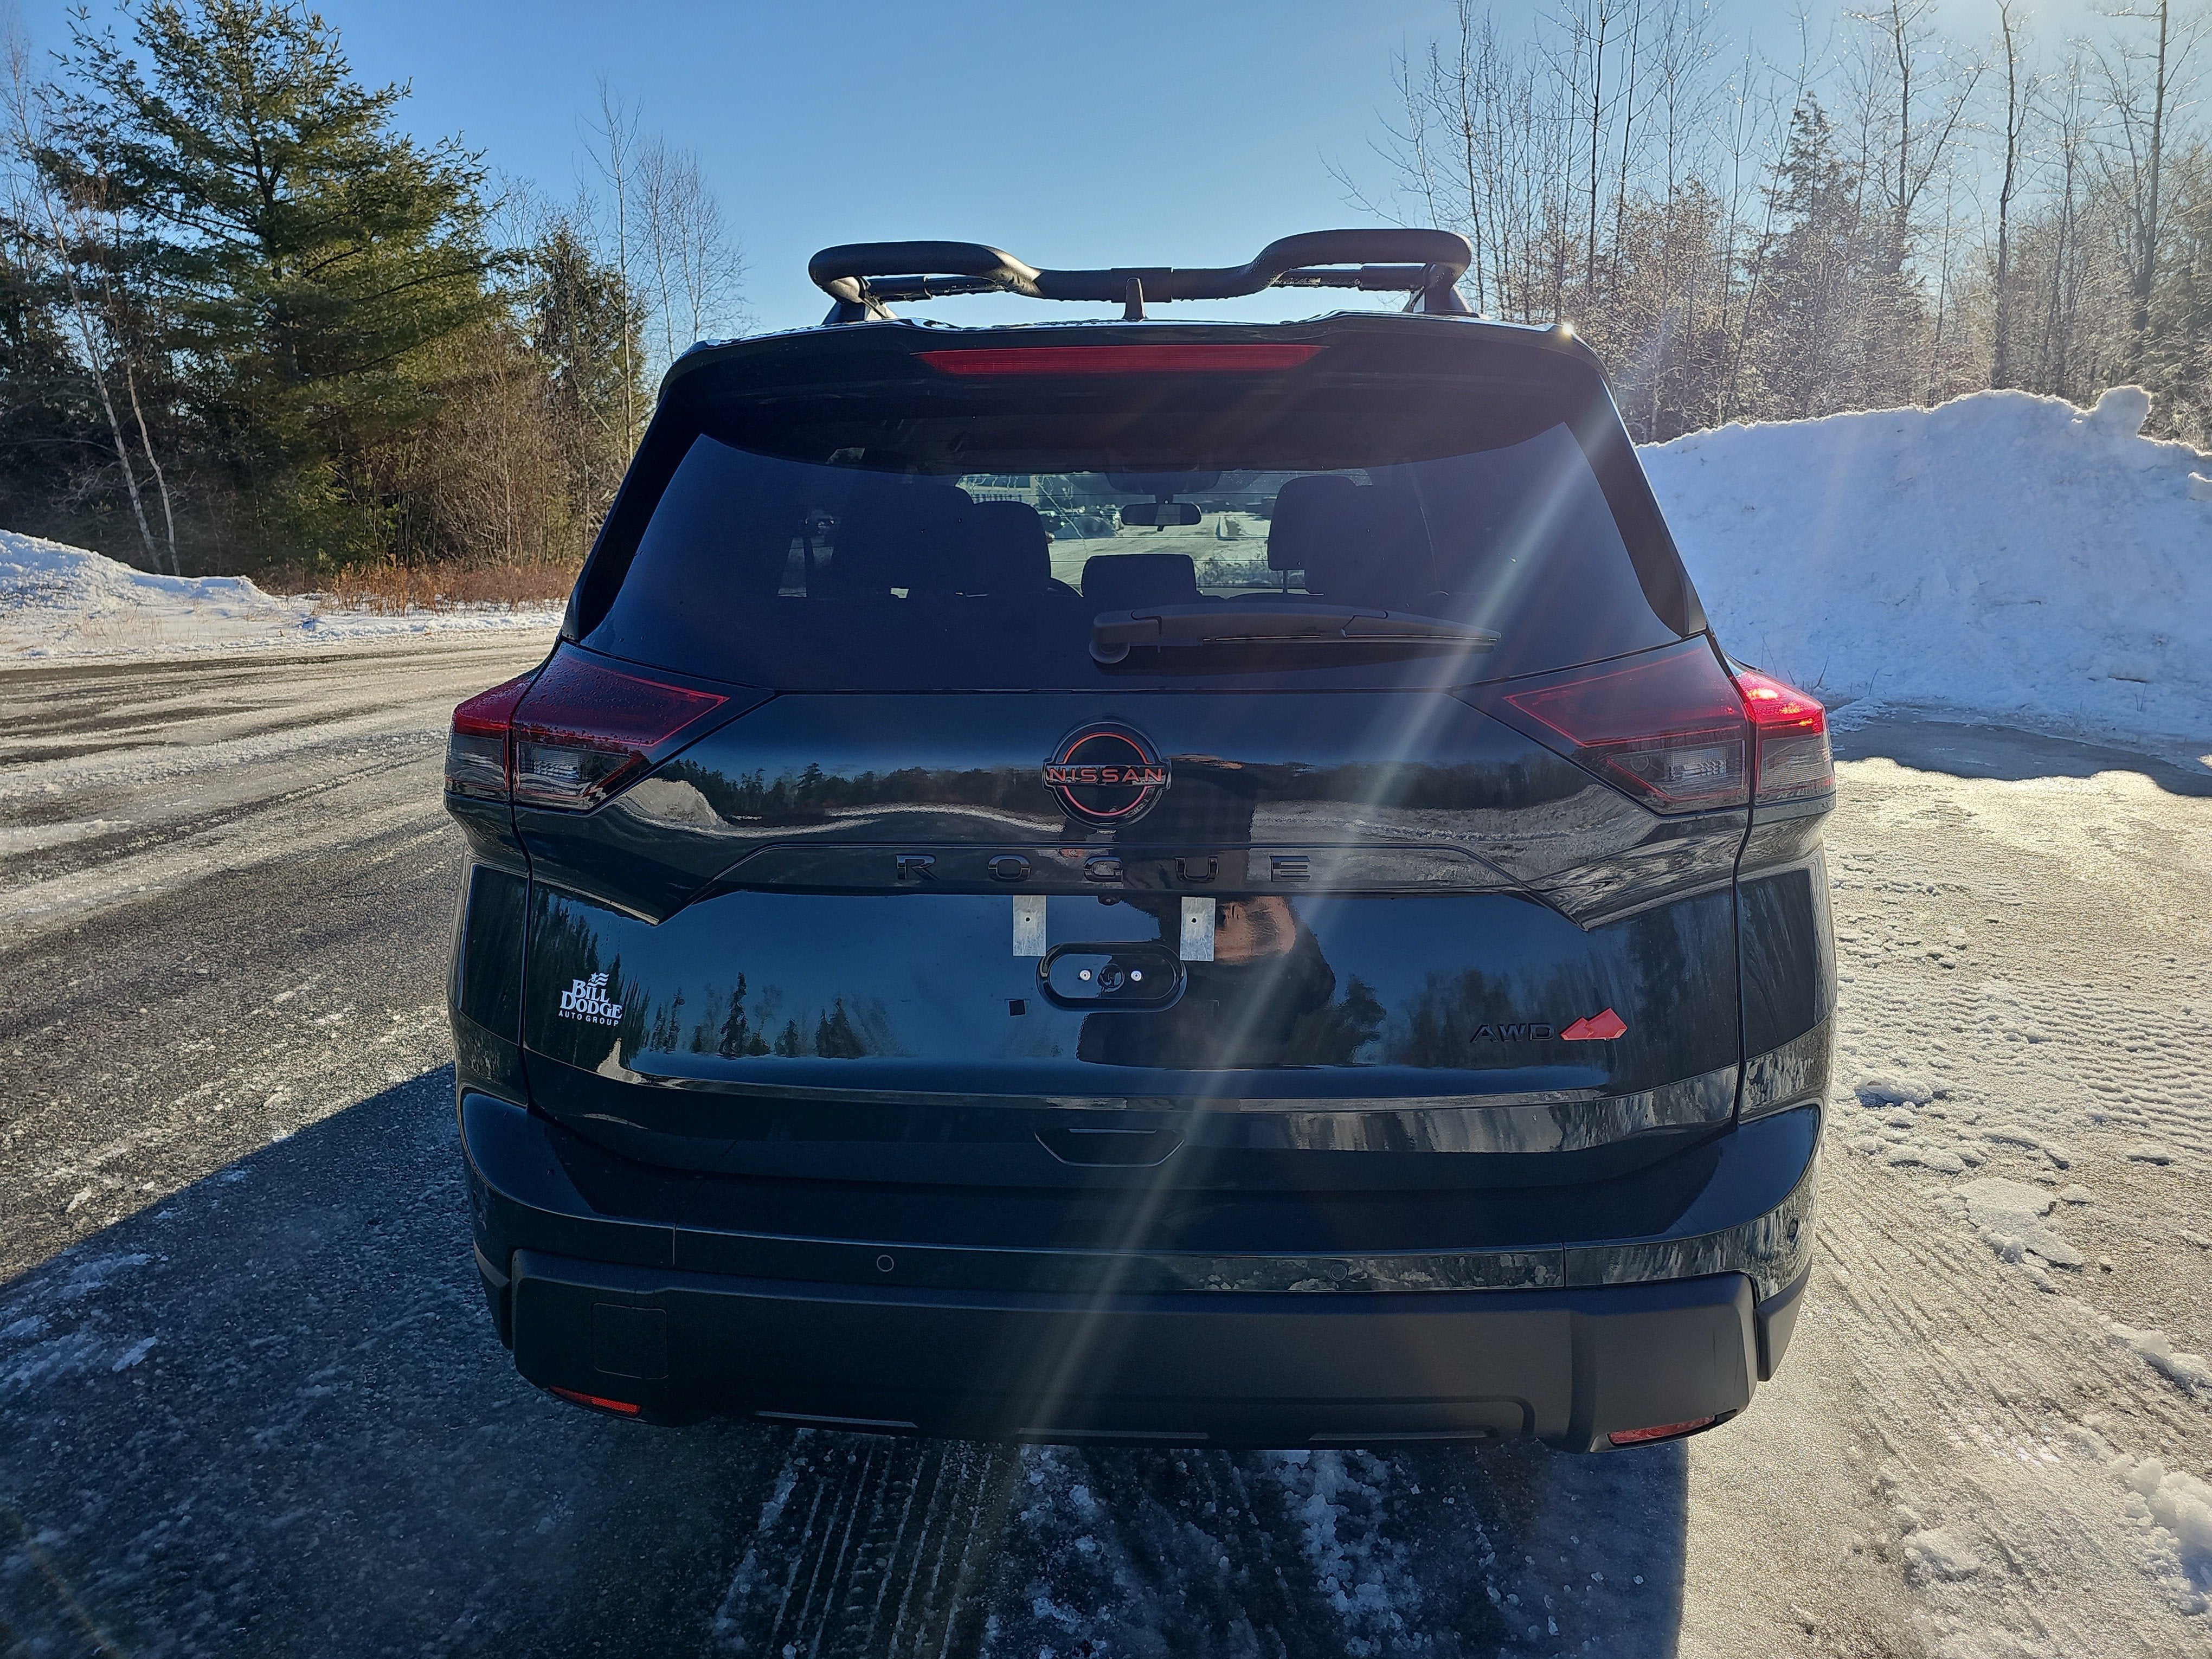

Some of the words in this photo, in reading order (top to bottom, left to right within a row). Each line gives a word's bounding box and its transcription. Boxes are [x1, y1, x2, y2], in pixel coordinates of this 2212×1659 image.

[1048, 768, 1163, 783] NISSAN
[896, 853, 1311, 883] ROGUE
[572, 979, 610, 1003] BILL
[560, 991, 623, 1019] DODGE
[558, 1010, 582, 1020] AUTO
[586, 1015, 619, 1026] GROUP
[1469, 1023, 1555, 1043] AWD
